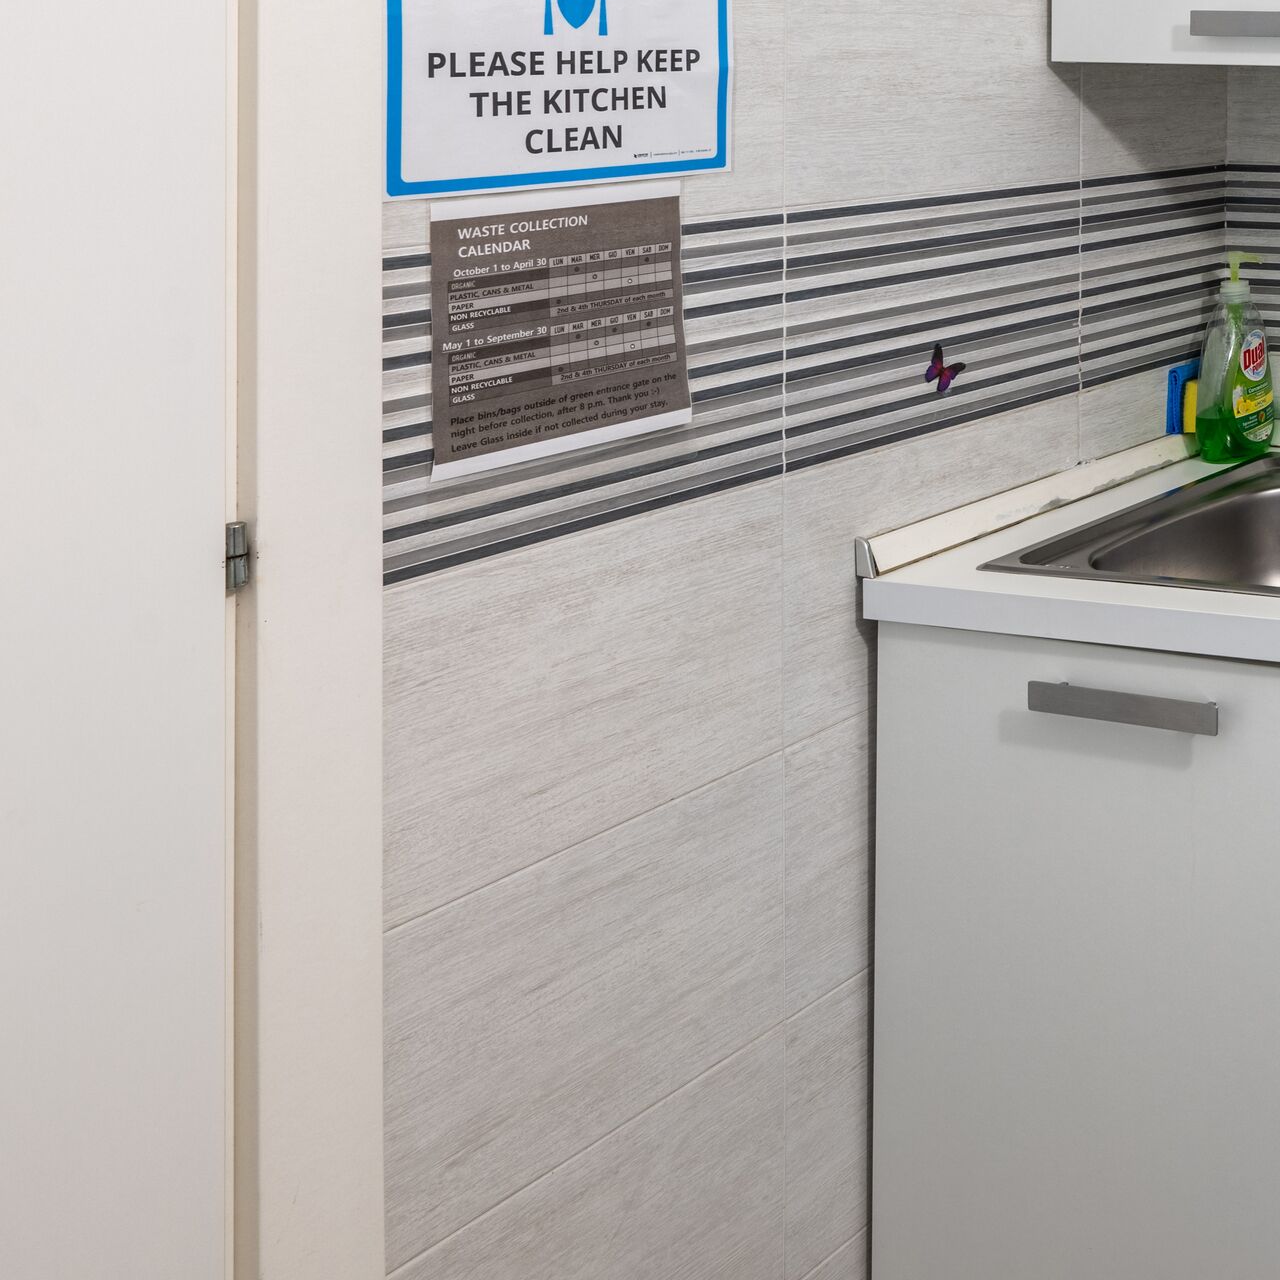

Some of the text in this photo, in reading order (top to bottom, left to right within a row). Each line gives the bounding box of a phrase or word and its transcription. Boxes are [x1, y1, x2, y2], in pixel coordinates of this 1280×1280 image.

[428, 49, 700, 78] PLEASE HELP KEEP
[470, 86, 666, 117] THE KITCHEN
[526, 125, 622, 154] CLEAN
[458, 215, 588, 239] WASTE COLLECTION
[458, 240, 531, 258] CALENDAR
[552, 257, 564, 265] LUN
[590, 252, 600, 260] MER
[454, 266, 490, 277] October
[494, 264, 498, 272] 1
[513, 260, 534, 270] April
[536, 258, 547, 266] 30
[451, 281, 476, 290] ORGANIC
[482, 288, 501, 296] CANS
[512, 283, 534, 292] METAL
[452, 302, 474, 311] PAPER
[590, 298, 623, 308] THURSDAY
[450, 306, 511, 321] NON RECYCLABLE
[452, 322, 474, 331] GLASS
[442, 341, 462, 351] May
[474, 338, 484, 346] to
[487, 330, 534, 344] September
[537, 326, 547, 335] 30
[452, 352, 476, 361] ORGANIC
[484, 358, 502, 366] CANS
[513, 352, 535, 360] METAL
[595, 363, 628, 373] THURSDAY
[452, 374, 474, 383] PAPER
[452, 377, 513, 394] NON RECYCLABLE
[451, 416, 474, 426] Place
[478, 407, 521, 421] bins/bags
[524, 398, 556, 410] outside
[559, 394, 568, 403] of
[570, 391, 594, 402] green
[596, 382, 630, 395] entrance
[632, 380, 649, 389] gate
[452, 394, 475, 403] GLASS
[451, 427, 475, 438] night
[479, 420, 508, 432] before
[511, 411, 554, 425] collection,
[557, 406, 577, 416] after
[588, 401, 605, 410] p.m.
[608, 392, 632, 404] Thank
[634, 391, 649, 400] you
[451, 441, 477, 453] Leave
[480, 435, 504, 446] Glass
[507, 429, 533, 440] inside
[545, 423, 559, 431] not
[562, 414, 599, 428] collected
[601, 407, 628, 419] during
[630, 404, 648, 413] your
[650, 400, 668, 409] stay.
